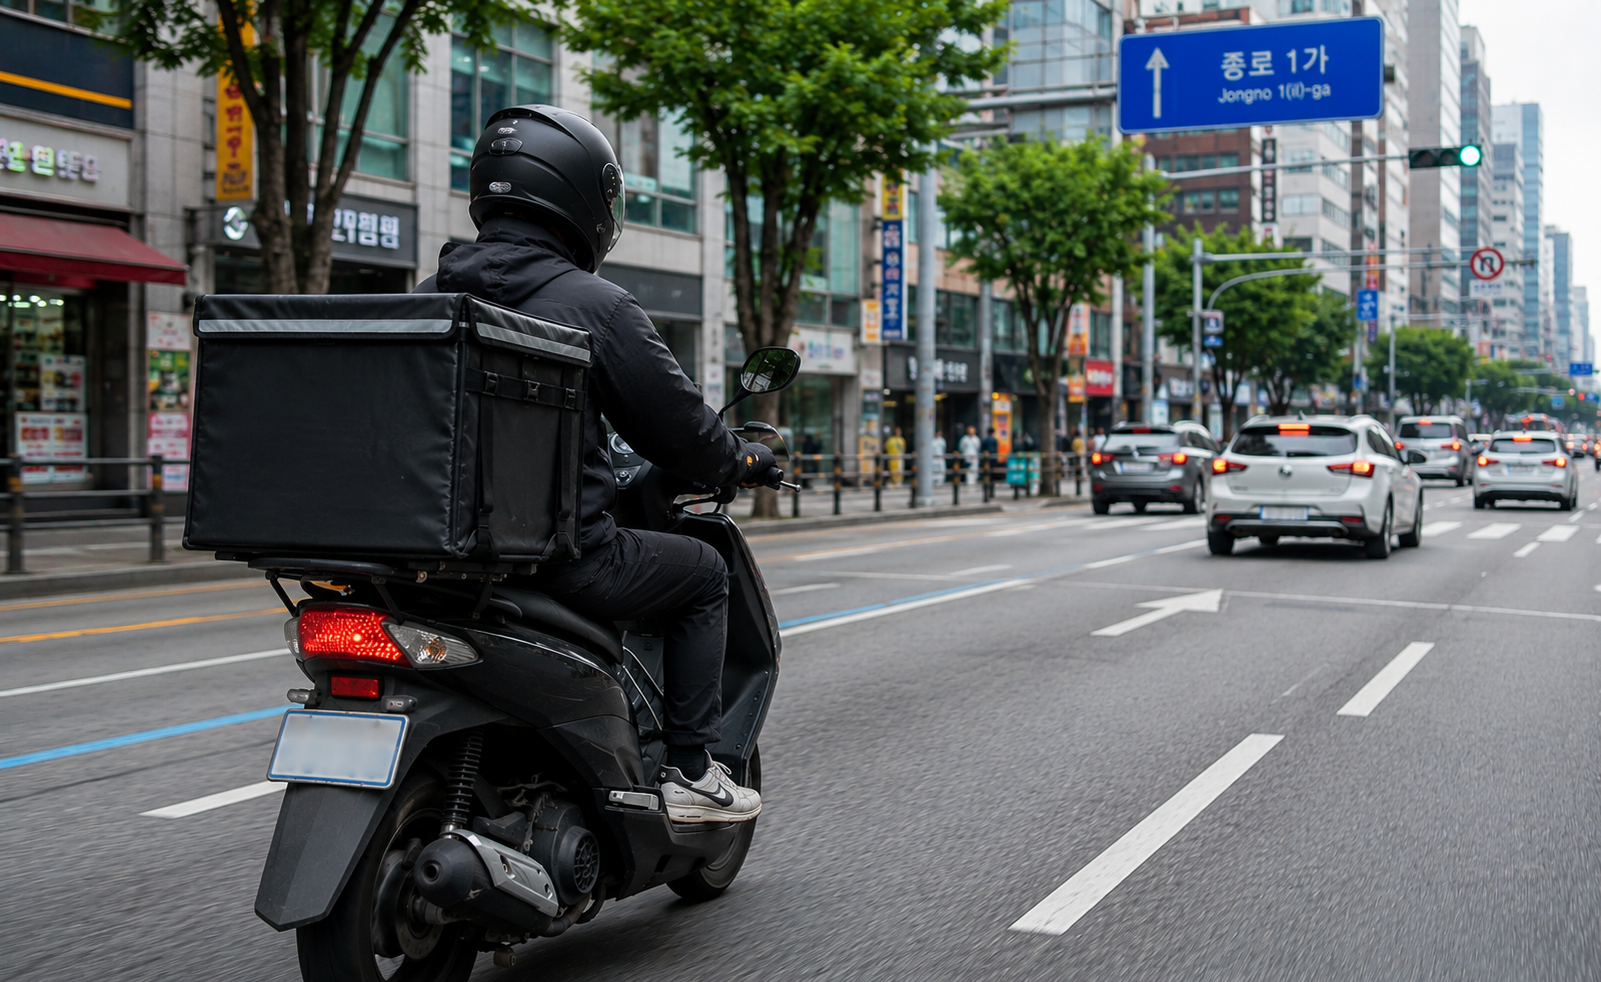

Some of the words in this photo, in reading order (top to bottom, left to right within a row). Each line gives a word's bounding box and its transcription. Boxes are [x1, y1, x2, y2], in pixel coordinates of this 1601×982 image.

[1221, 50, 1275, 81] 종로
[1286, 44, 1329, 74] 1가
[1218, 87, 1272, 105] Jongno
[1278, 81, 1331, 101] 1(il)-ga
